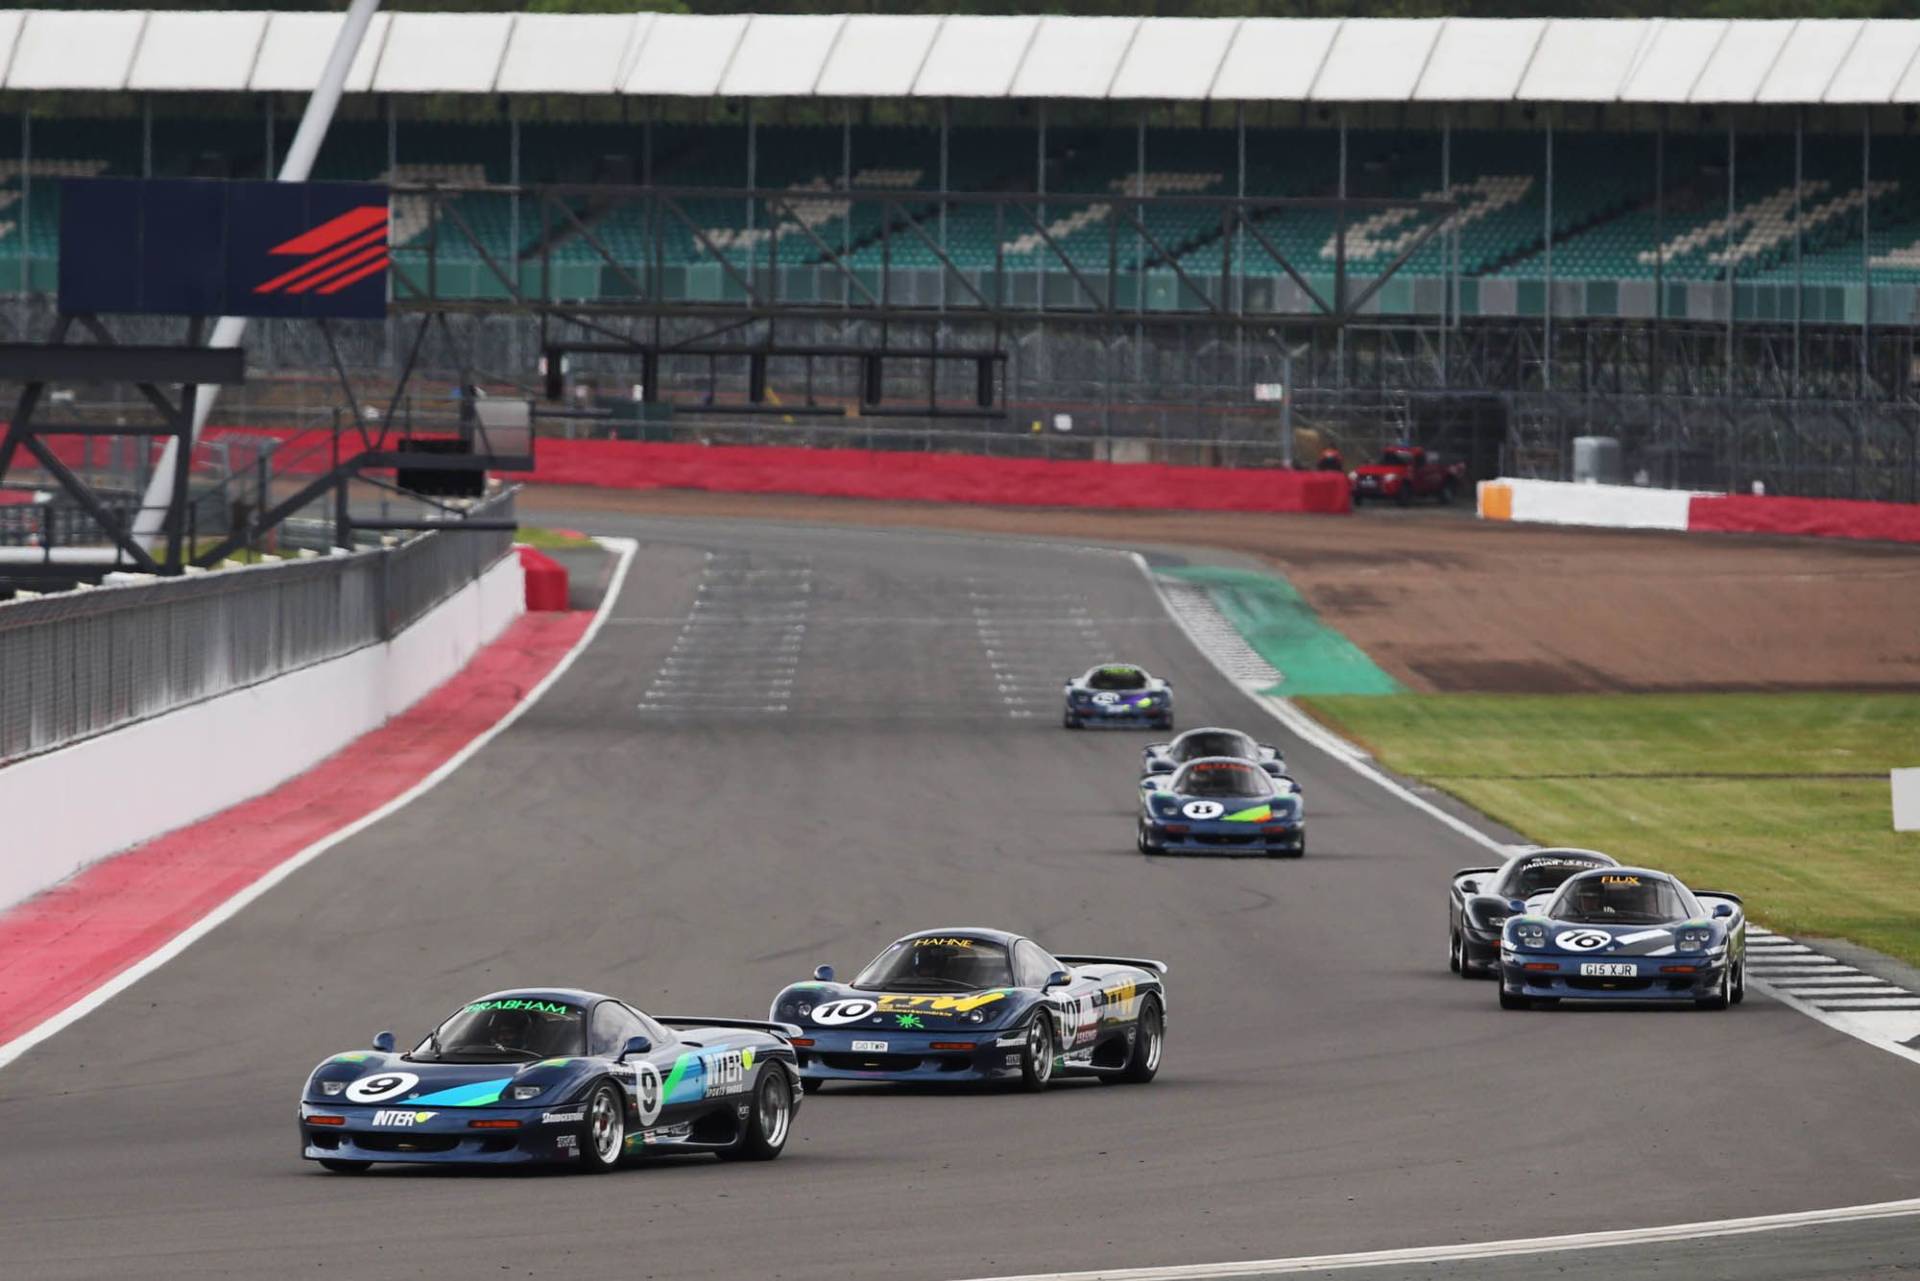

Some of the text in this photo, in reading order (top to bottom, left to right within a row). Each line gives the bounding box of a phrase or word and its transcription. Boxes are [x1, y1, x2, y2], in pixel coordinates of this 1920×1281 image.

[1601, 875, 1639, 885] FLUX
[912, 938, 974, 948] HAHNE
[1564, 931, 1608, 948] 16
[1610, 965, 1632, 976] XJR
[464, 999, 567, 1015] BRABHAM
[822, 1002, 865, 1018] 10
[359, 1077, 404, 1095] 9
[641, 1067, 657, 1113] 9
[372, 1110, 416, 1126] INTER
